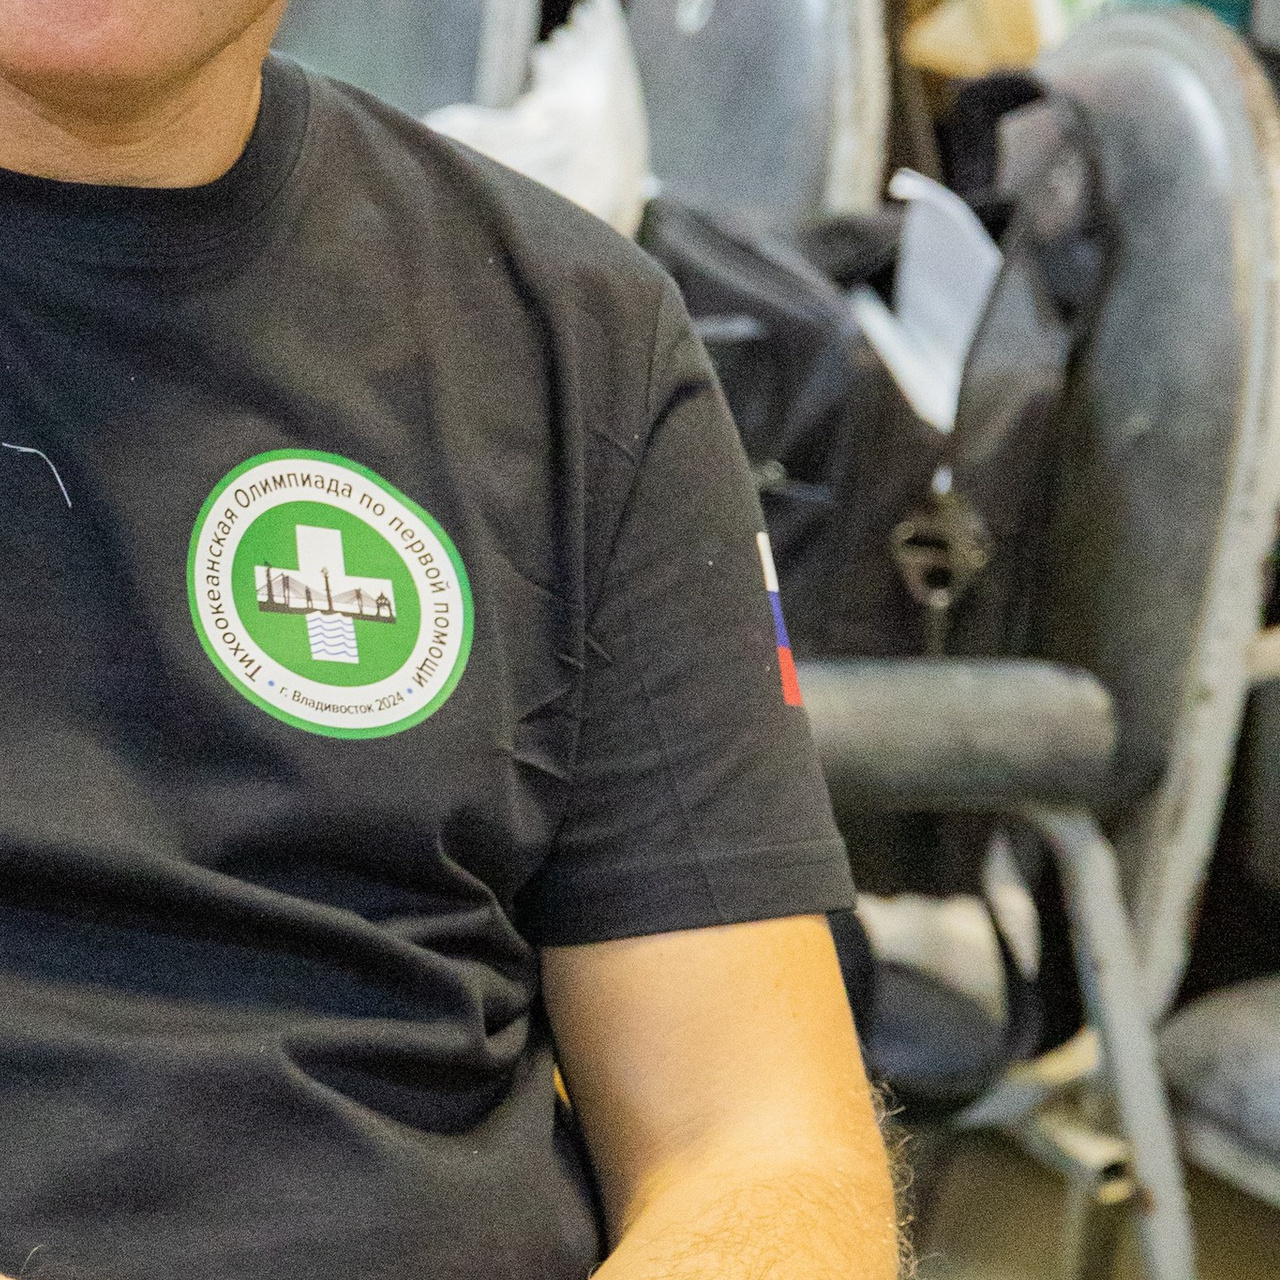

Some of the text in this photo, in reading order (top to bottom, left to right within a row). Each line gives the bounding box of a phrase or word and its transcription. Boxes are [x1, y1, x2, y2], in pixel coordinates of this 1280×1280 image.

[206, 472, 451, 688] Тихоокеанская Олимпиада по первой помощи
[279, 686, 405, 715] г. Владивосток 2024
